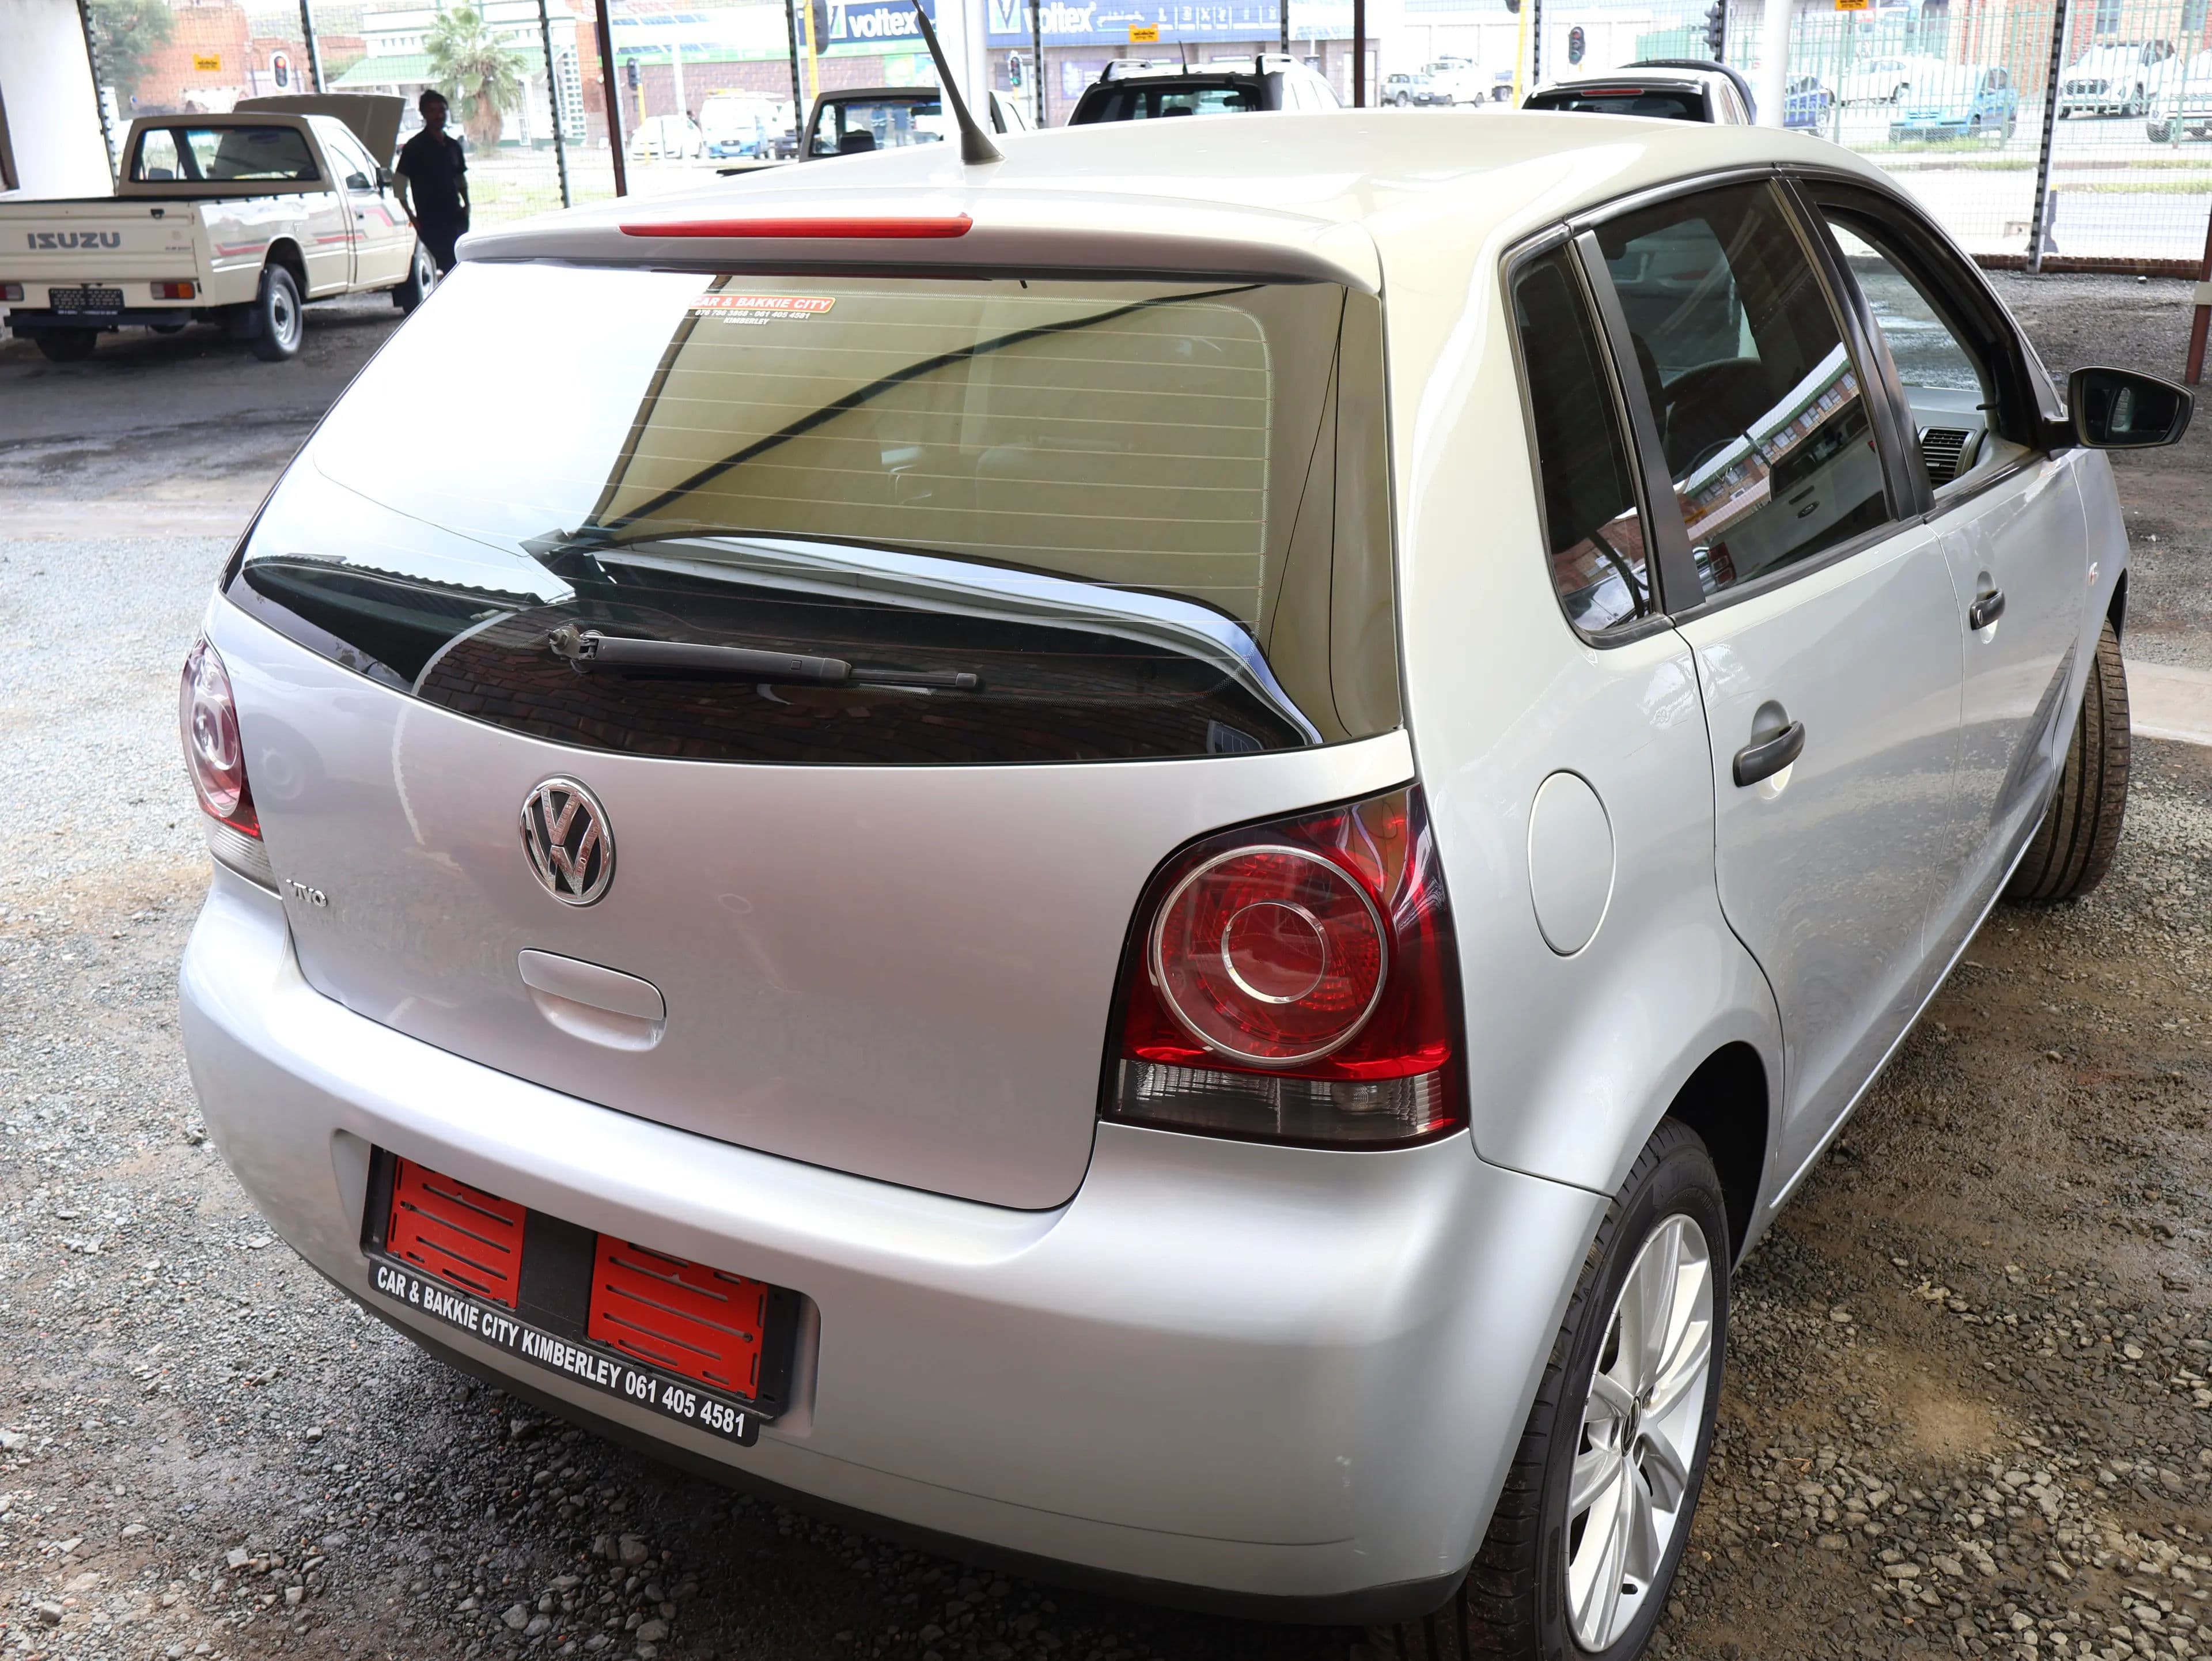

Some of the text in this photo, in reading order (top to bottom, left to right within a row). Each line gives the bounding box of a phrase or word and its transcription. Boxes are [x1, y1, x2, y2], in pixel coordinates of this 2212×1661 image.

[848, 8, 919, 38] voltex
[28, 232, 121, 249] ISUZU
[691, 297, 831, 309] CAR & BAKKIE CITY
[377, 1266, 745, 1437] CAR & BAKKIE CITY KIMBERLEY 061 405 4581
